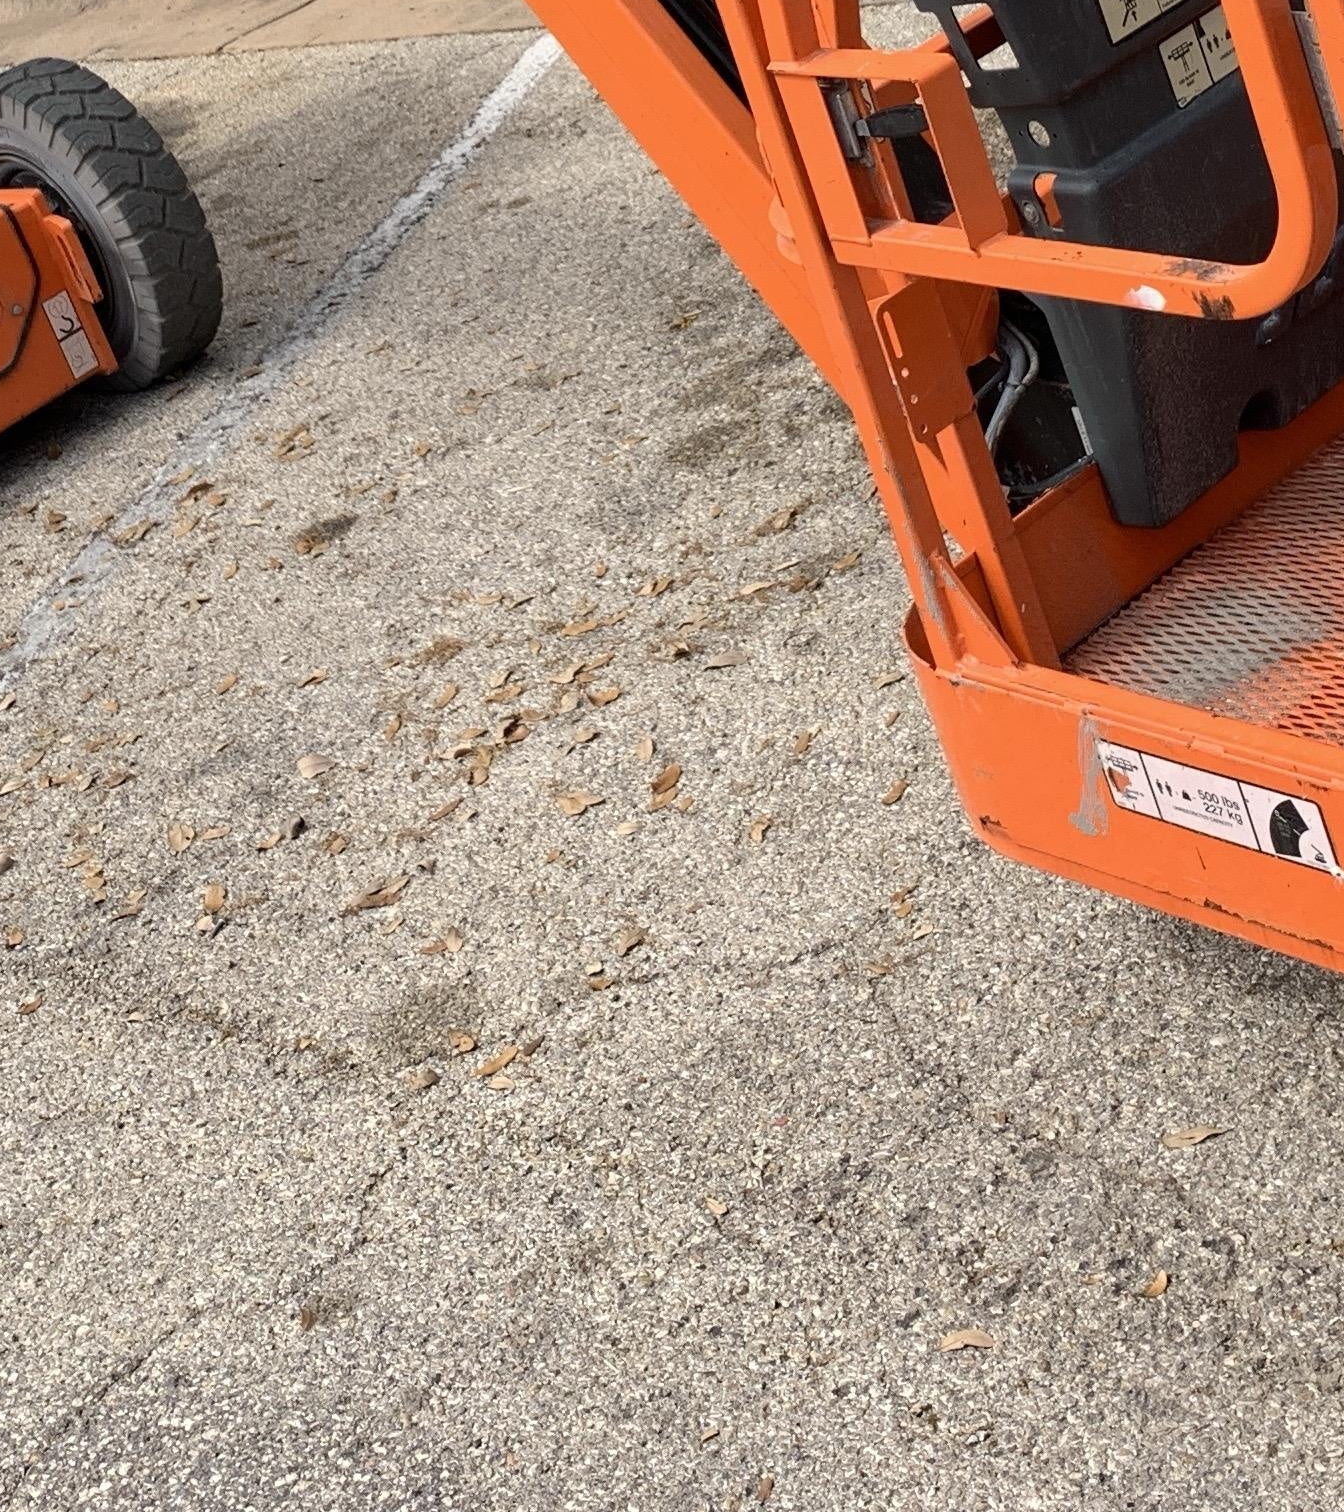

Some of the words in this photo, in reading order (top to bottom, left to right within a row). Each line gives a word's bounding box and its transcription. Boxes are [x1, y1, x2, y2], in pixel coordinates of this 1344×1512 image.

[1197, 789, 1220, 805] 500
[1221, 793, 1241, 811] lbs
[1204, 802, 1223, 818] 227
[1228, 810, 1244, 825] kg
